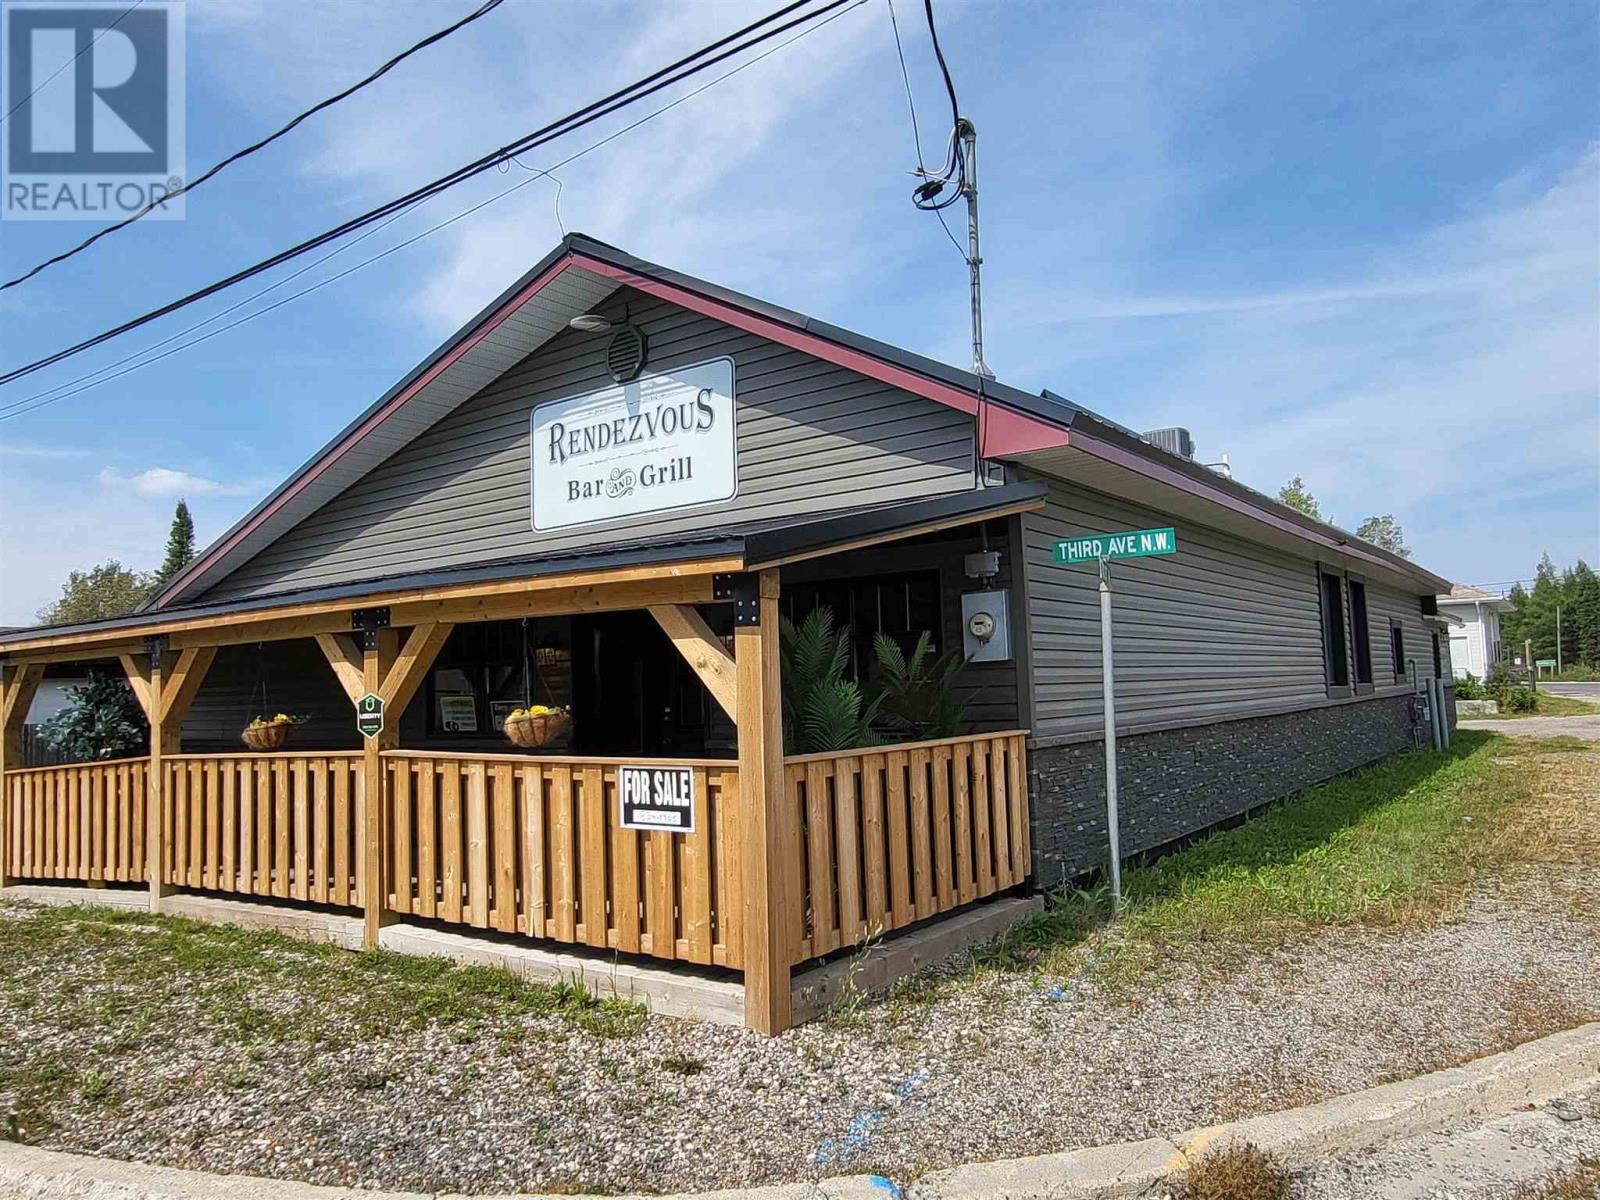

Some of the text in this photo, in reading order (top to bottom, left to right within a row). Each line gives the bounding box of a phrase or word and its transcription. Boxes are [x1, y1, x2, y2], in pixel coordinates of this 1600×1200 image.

[549, 388, 714, 464] RENDEZVOUS
[567, 478, 604, 502] Bar
[639, 456, 693, 487] Grill
[1058, 533, 1171, 560] THIRD AVE N.W.
[624, 770, 690, 807] FOR SALE
